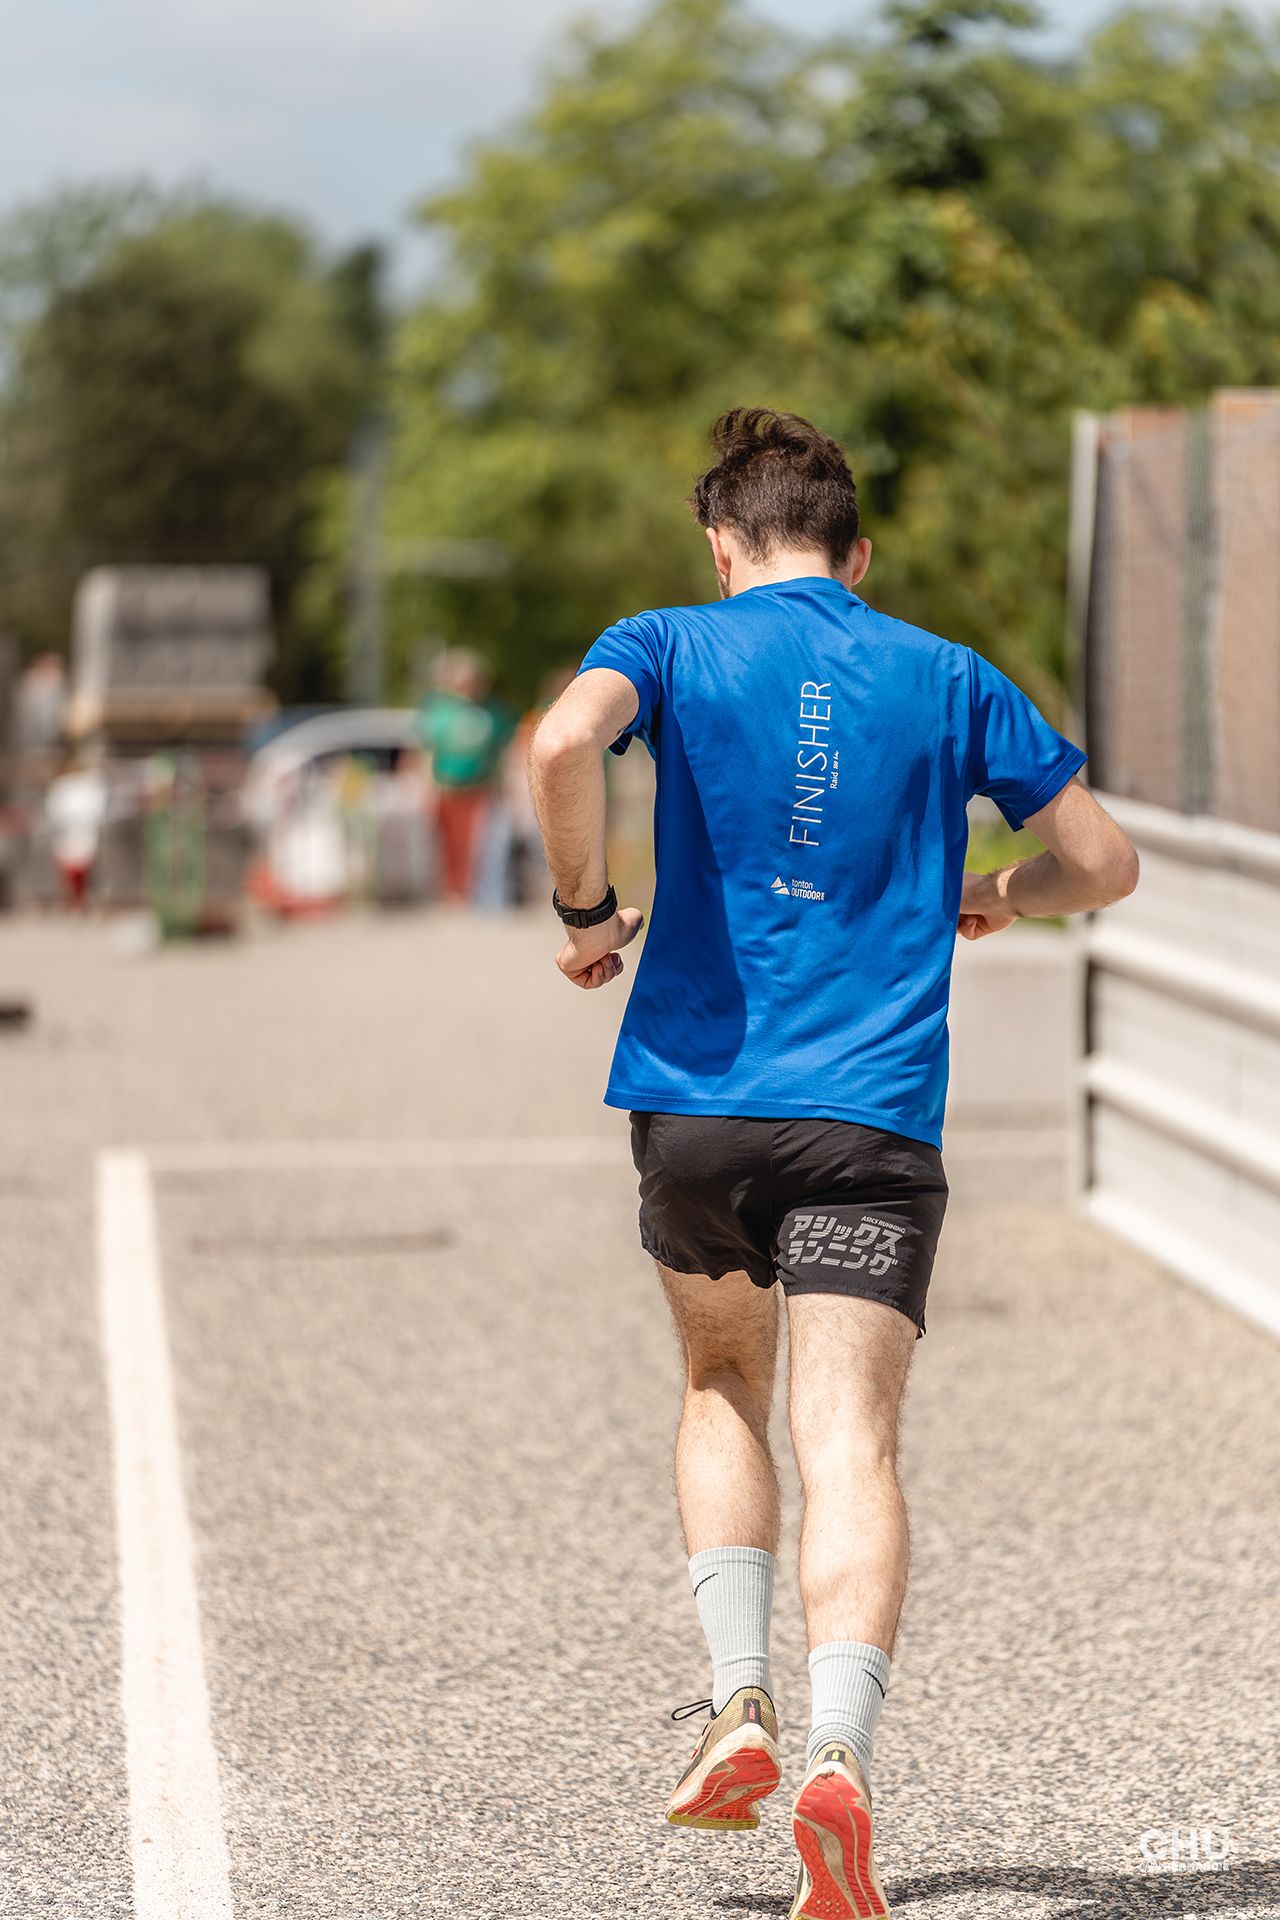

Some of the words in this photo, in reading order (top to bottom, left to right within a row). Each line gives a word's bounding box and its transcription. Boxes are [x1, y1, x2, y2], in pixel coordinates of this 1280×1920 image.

[788, 681, 832, 846] FINISHER
[829, 771, 839, 790] Raid
[791, 878, 814, 890] tonton
[788, 1215, 903, 1256] アシックス
[861, 1215, 878, 1226] ASICS
[878, 1220, 906, 1234] RUNNING
[788, 1240, 898, 1276] ランニング
